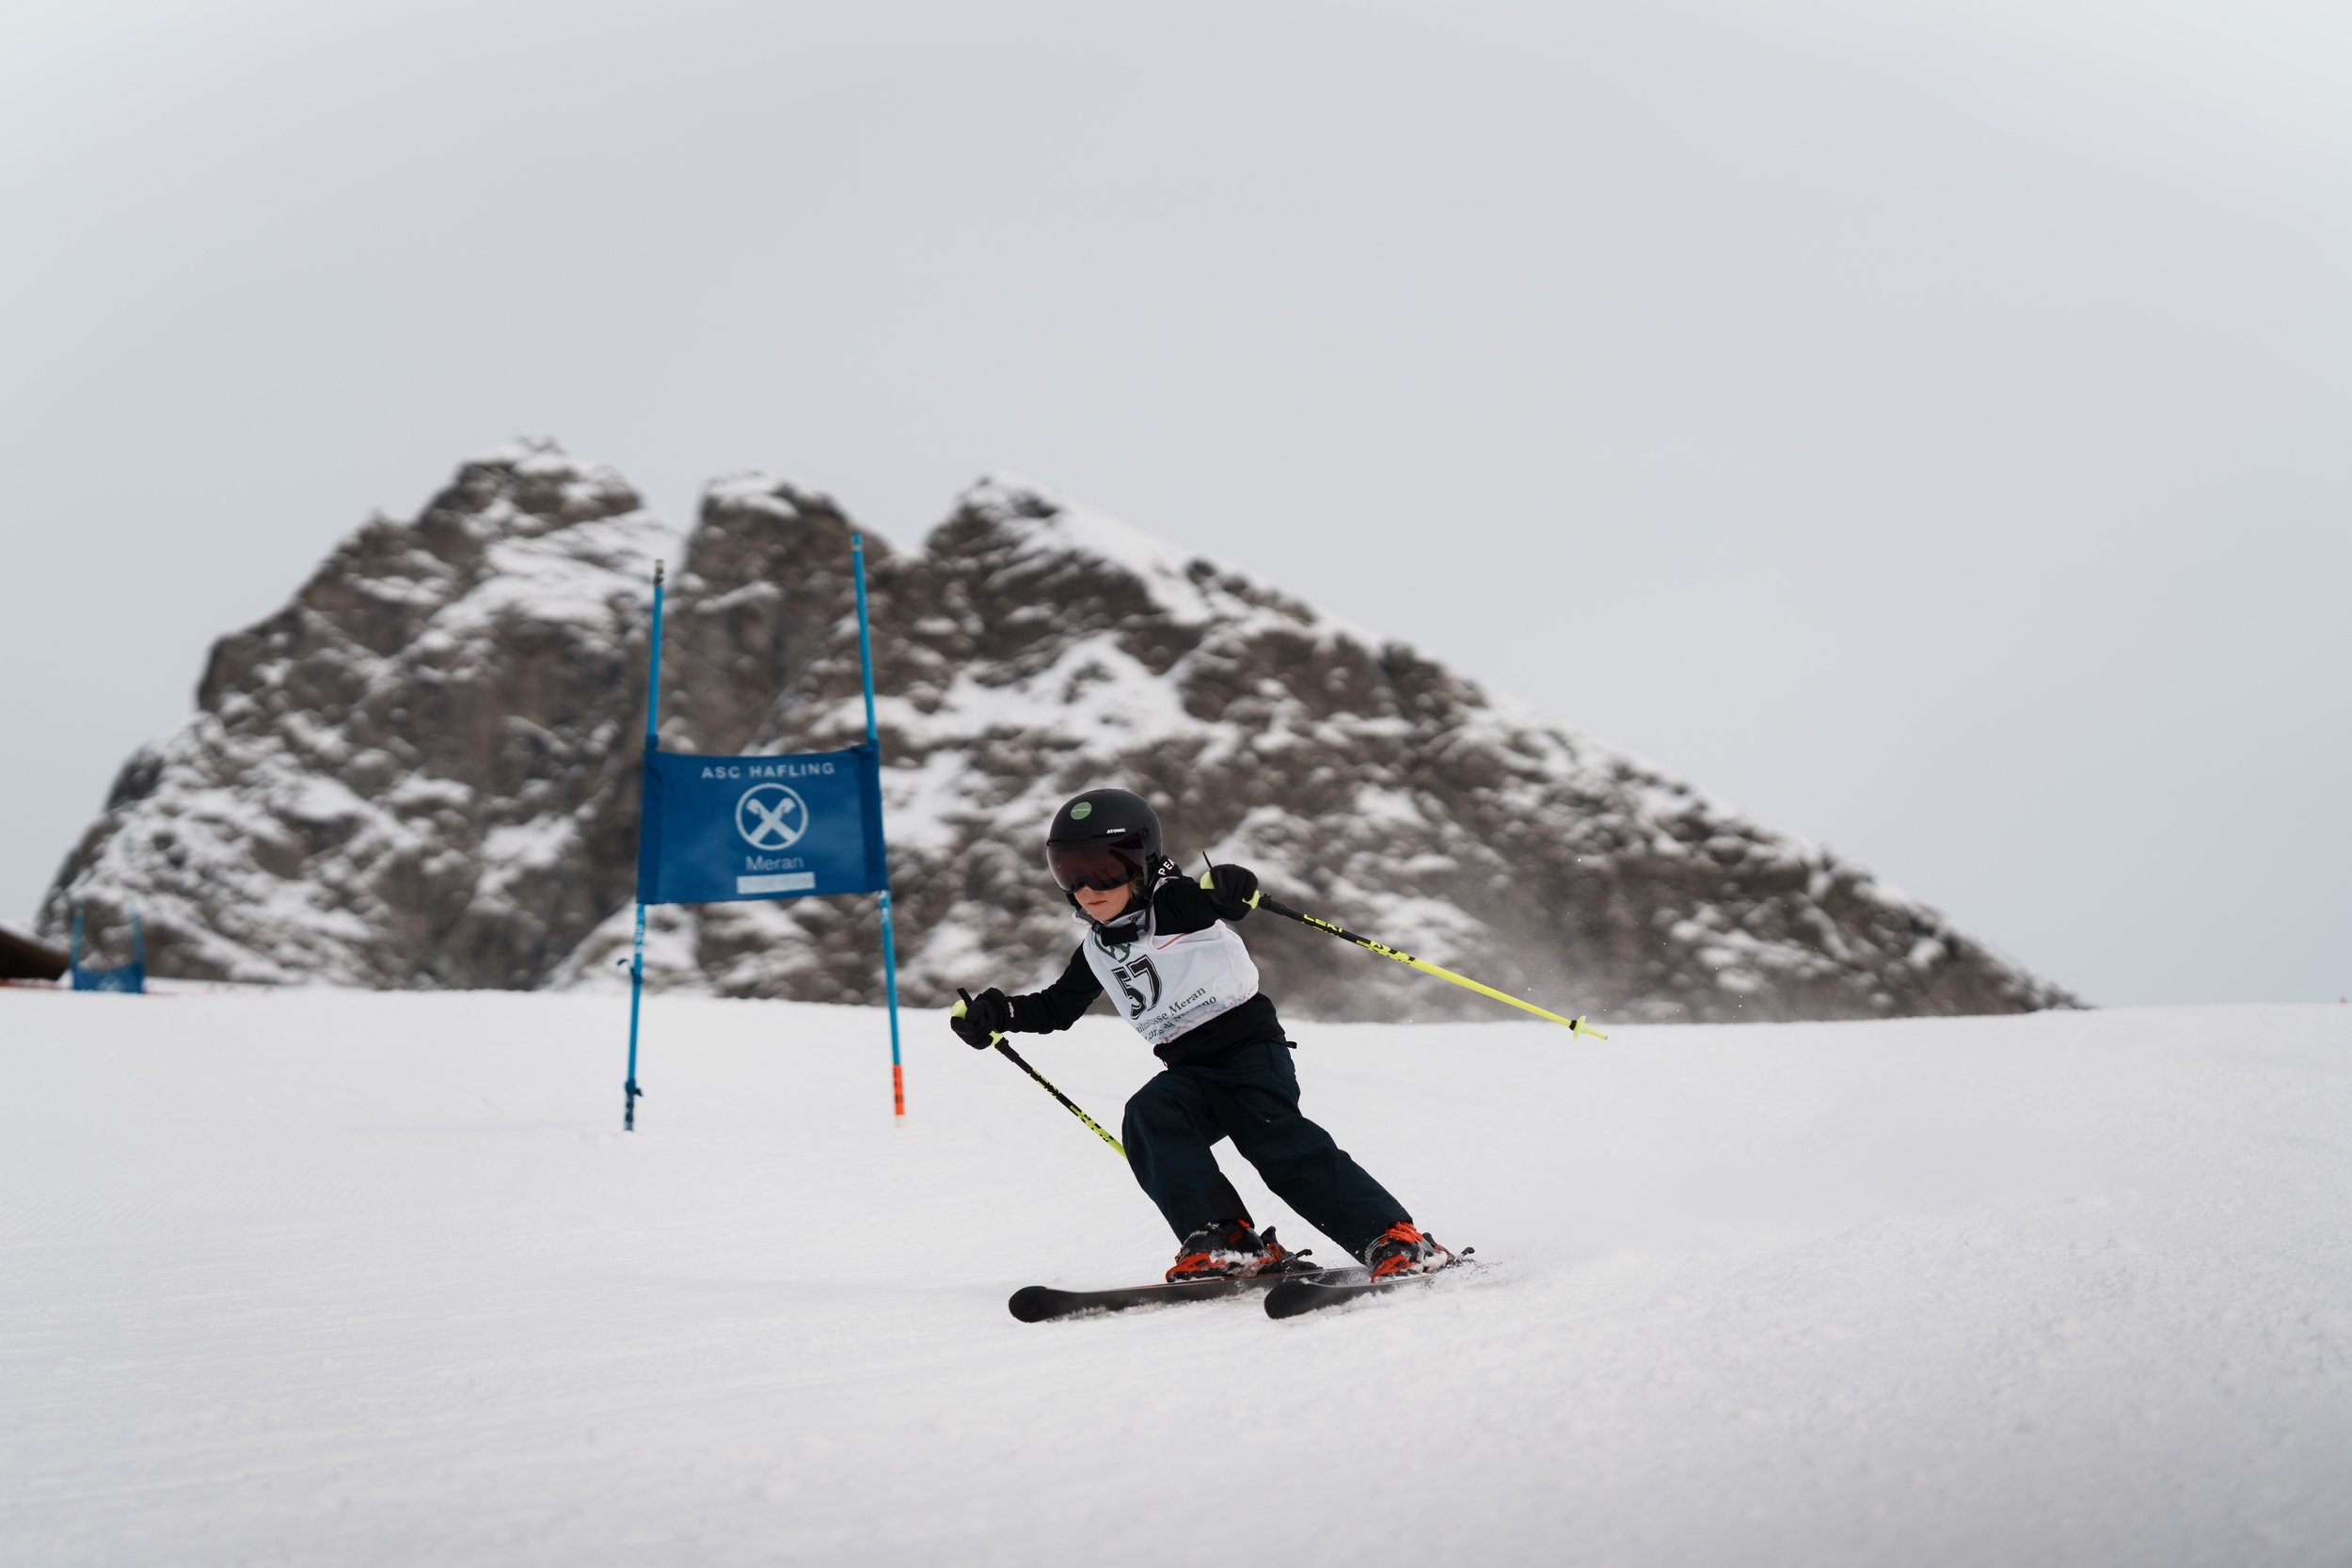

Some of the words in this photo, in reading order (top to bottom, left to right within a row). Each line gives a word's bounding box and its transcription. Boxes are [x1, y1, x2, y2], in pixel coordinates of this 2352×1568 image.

[701, 766, 741, 779] ASC
[749, 762, 835, 778] HAFLING
[745, 855, 804, 871] Meran
[1111, 954, 1163, 1021] 57
[1168, 987, 1206, 1016] Meran
